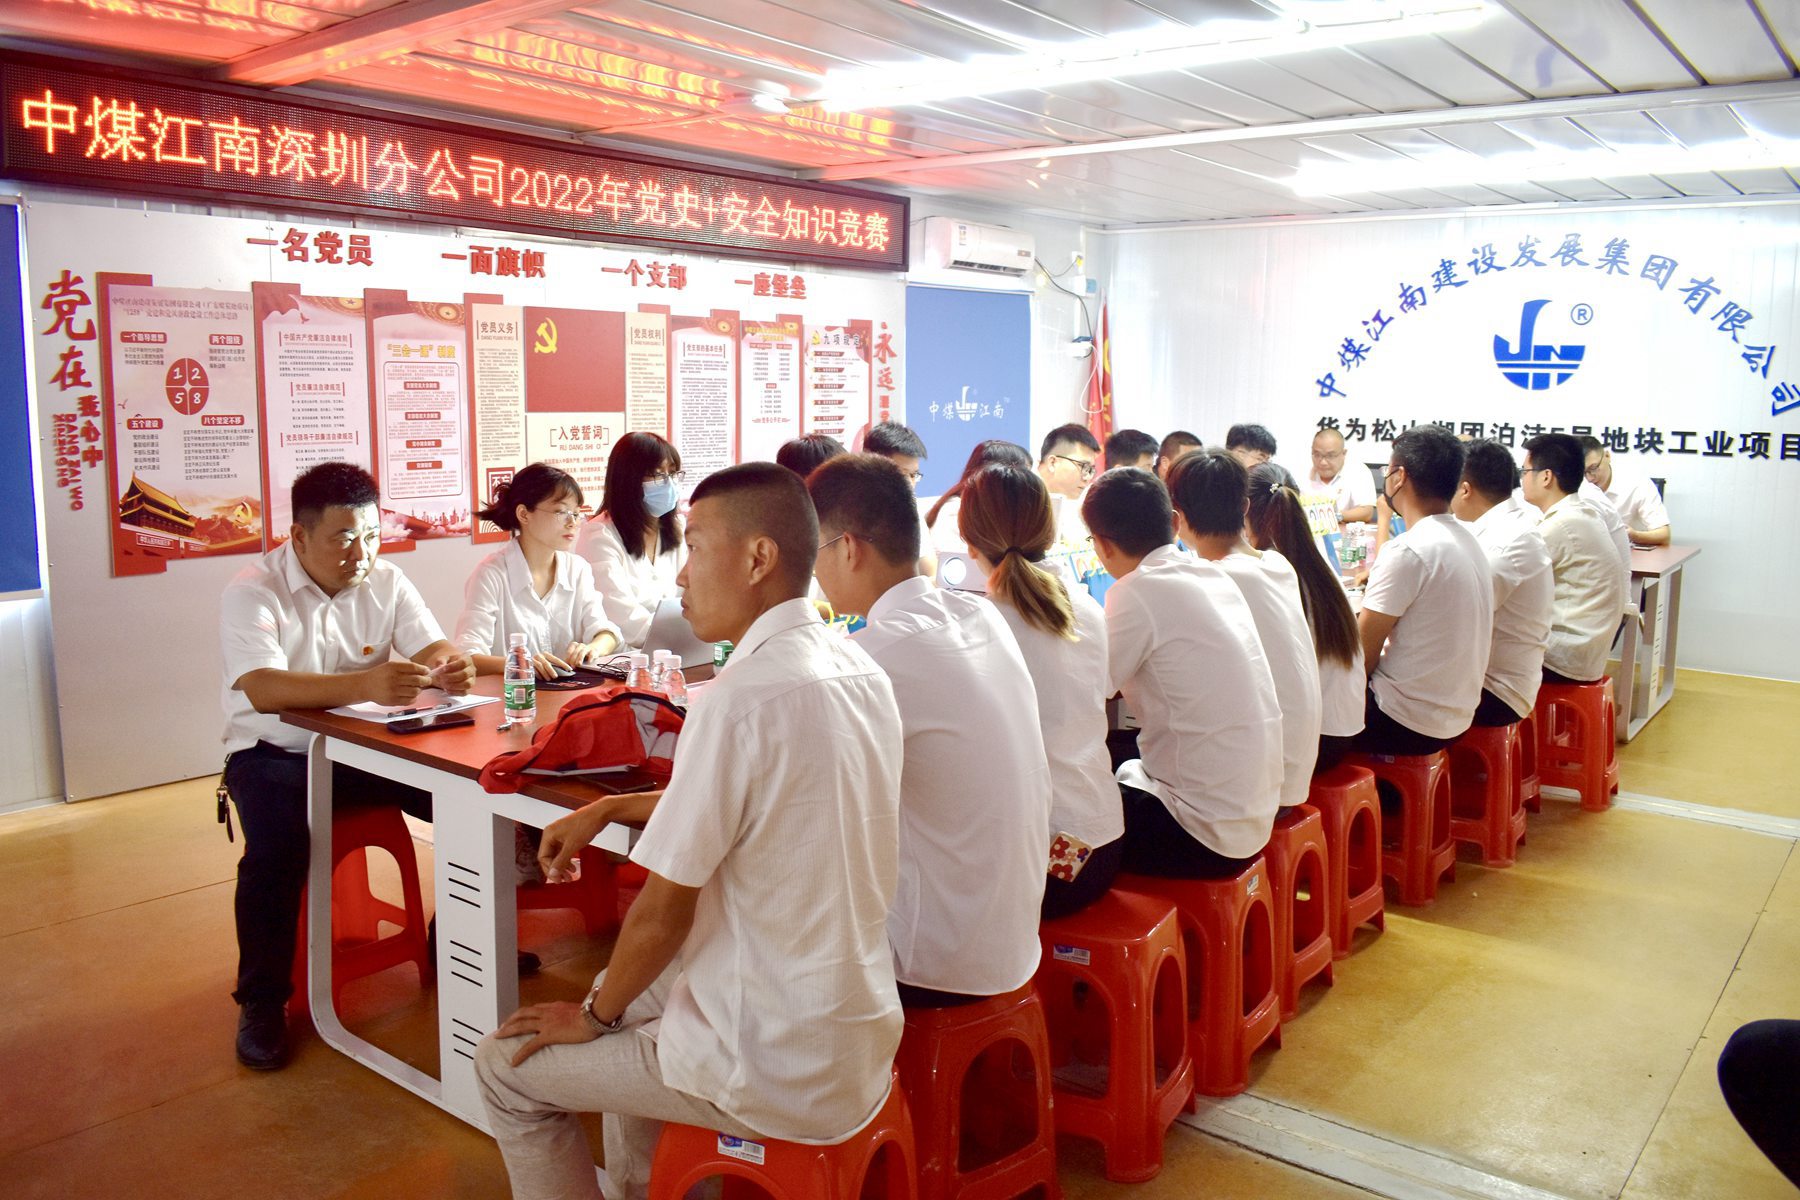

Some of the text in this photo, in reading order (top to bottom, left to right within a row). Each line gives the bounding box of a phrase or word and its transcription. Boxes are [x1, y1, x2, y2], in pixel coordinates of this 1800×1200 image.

[22, 89, 891, 252] 中煤江南深圳分公司2022年党史+安全知识竞赛
[247, 228, 374, 266] 一名党员
[441, 245, 547, 279] 一面旗帜
[601, 259, 687, 290] 一个支部
[735, 272, 807, 300] 一座堡垒
[481, 321, 514, 334] 党员义务
[1315, 233, 1800, 417] 中煤江南建设发展集团有限公司
[823, 333, 860, 346] 九项规定
[173, 367, 183, 380] 1
[191, 367, 201, 380] 2
[174, 392, 185, 405] 5
[192, 392, 201, 405] 8
[558, 425, 602, 441] 入党誓词
